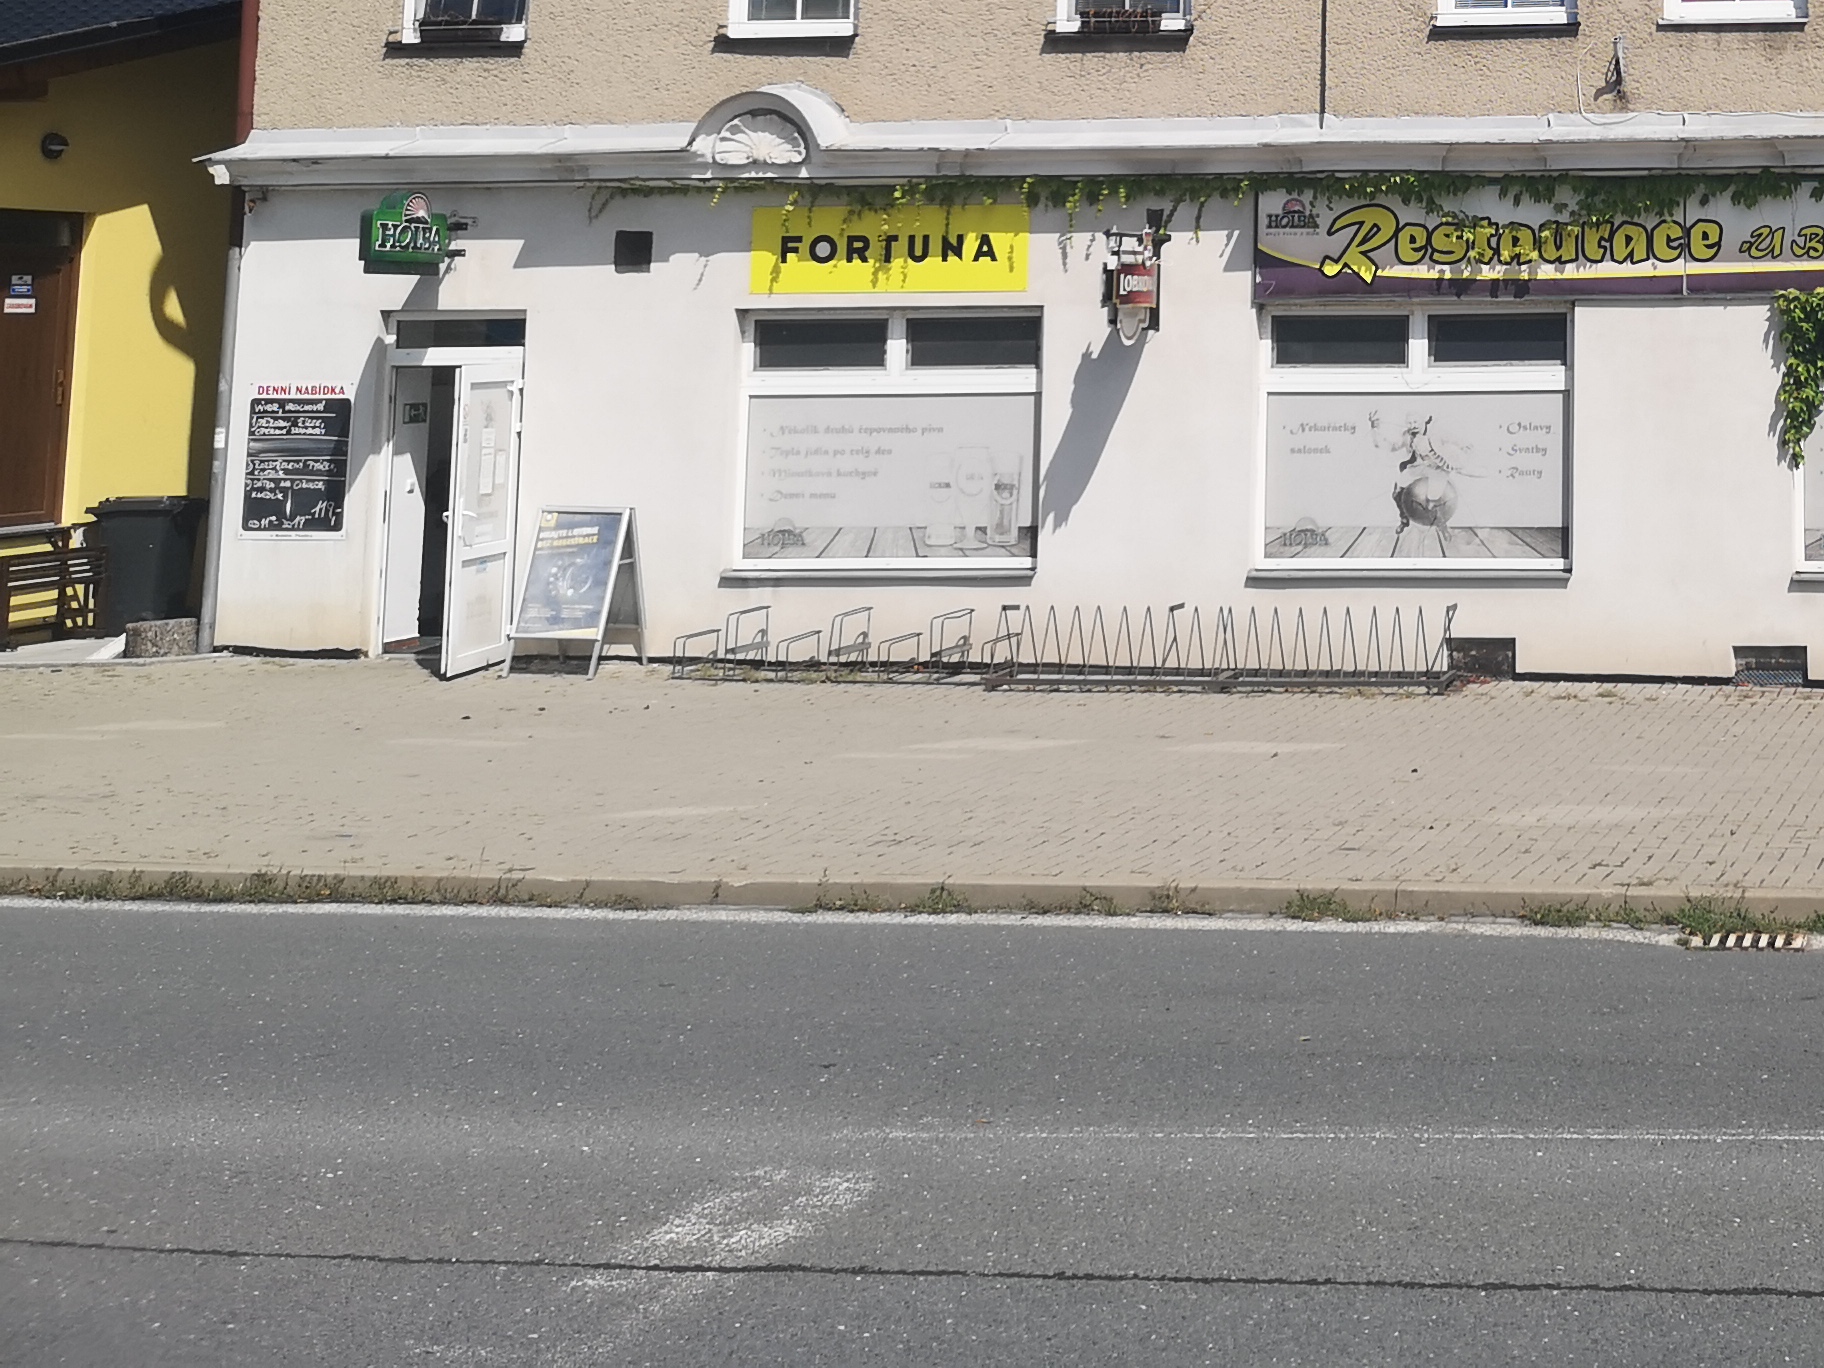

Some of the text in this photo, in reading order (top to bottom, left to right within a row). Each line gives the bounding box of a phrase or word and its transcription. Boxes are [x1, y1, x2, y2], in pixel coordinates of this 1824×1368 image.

[1266, 213, 1320, 229] HOLBA
[375, 221, 443, 252] HOLBA
[780, 234, 998, 264] FORTUNA
[1318, 203, 1723, 285] Restaurace
[257, 383, 346, 395] DENNÍ NABÍDKA
[921, 424, 944, 437] piva
[1506, 421, 1552, 435] Oslavy
[1506, 443, 1548, 456] Svatby
[1506, 466, 1543, 479] Rauty
[760, 533, 807, 547] HOLBA
[1281, 532, 1330, 547] HOLBA
